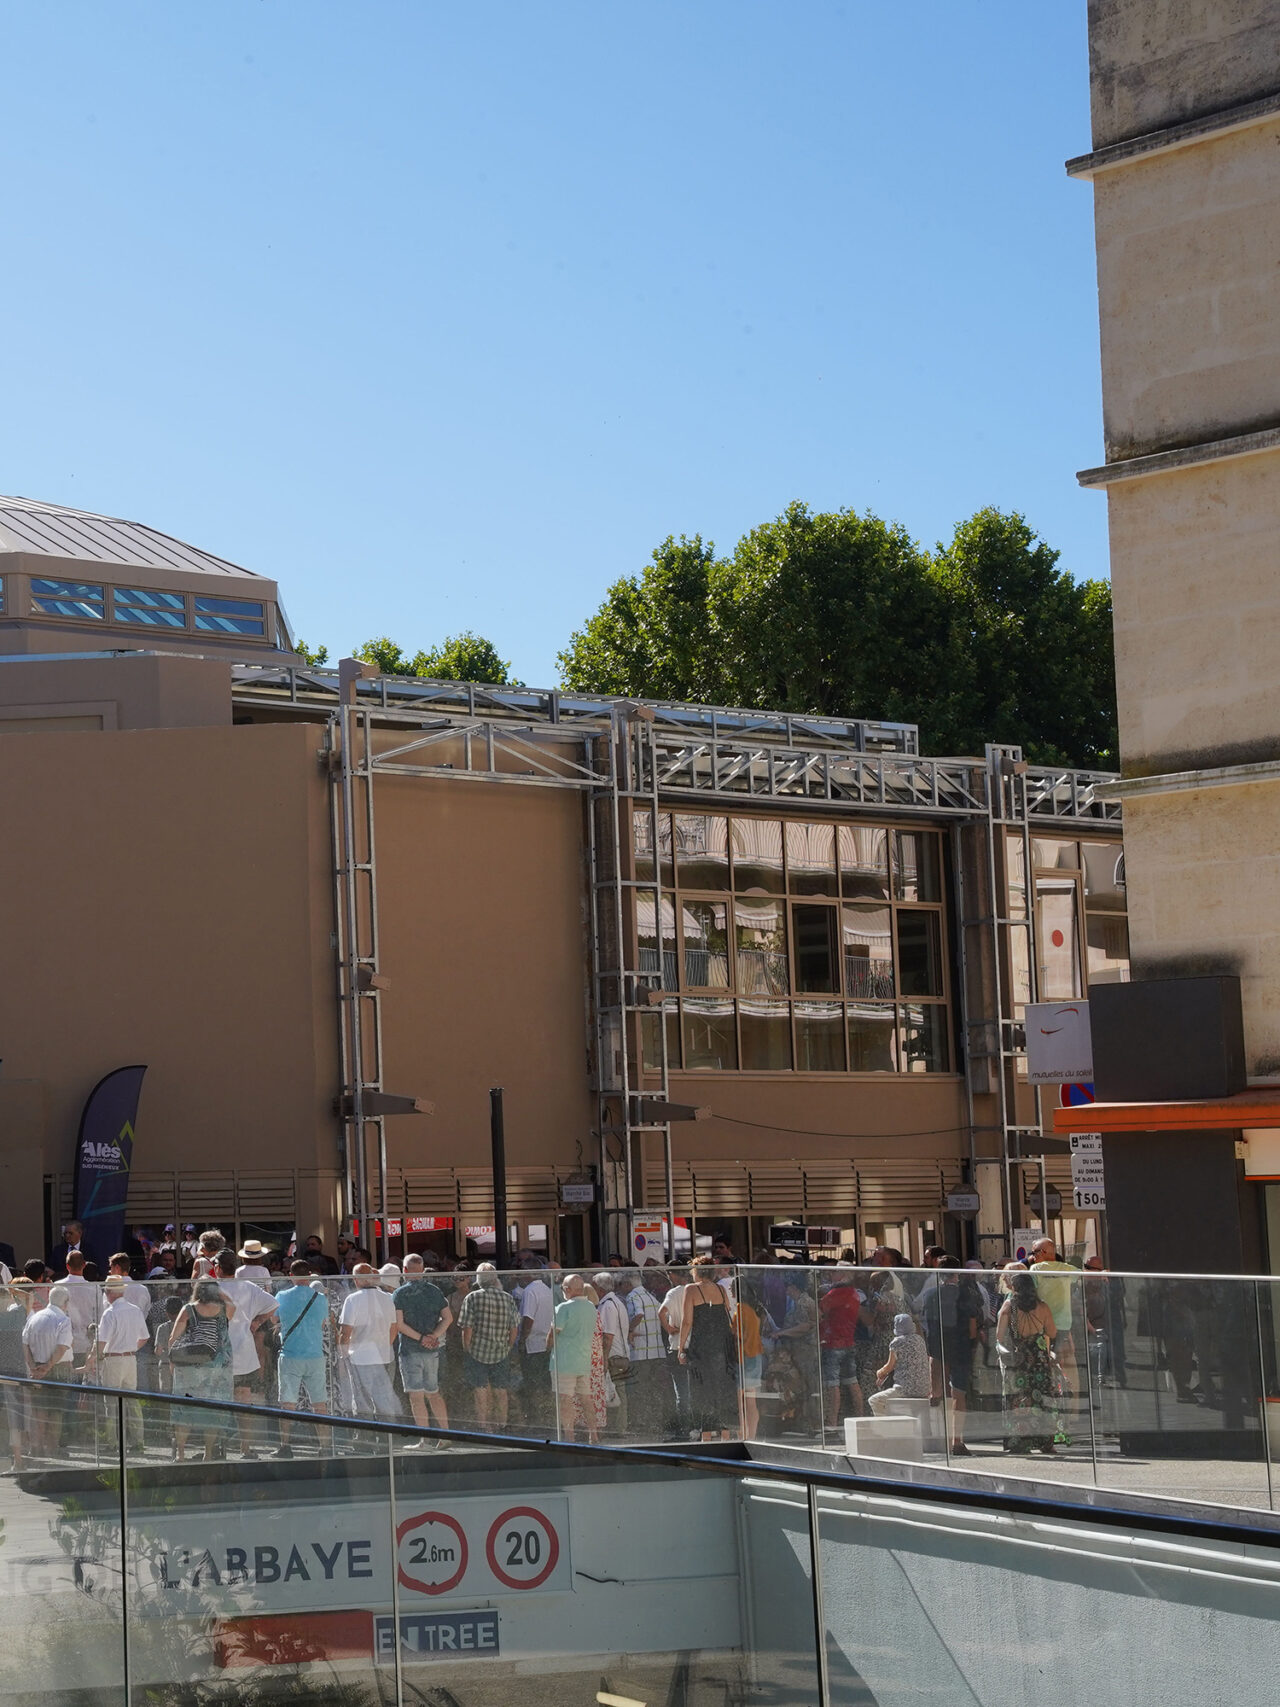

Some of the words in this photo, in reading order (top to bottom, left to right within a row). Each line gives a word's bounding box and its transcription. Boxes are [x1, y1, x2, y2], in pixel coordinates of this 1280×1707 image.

[81, 1140, 121, 1159] Alès
[158, 1540, 374, 1590] L'ABBAYE
[505, 1530, 541, 1566] 20
